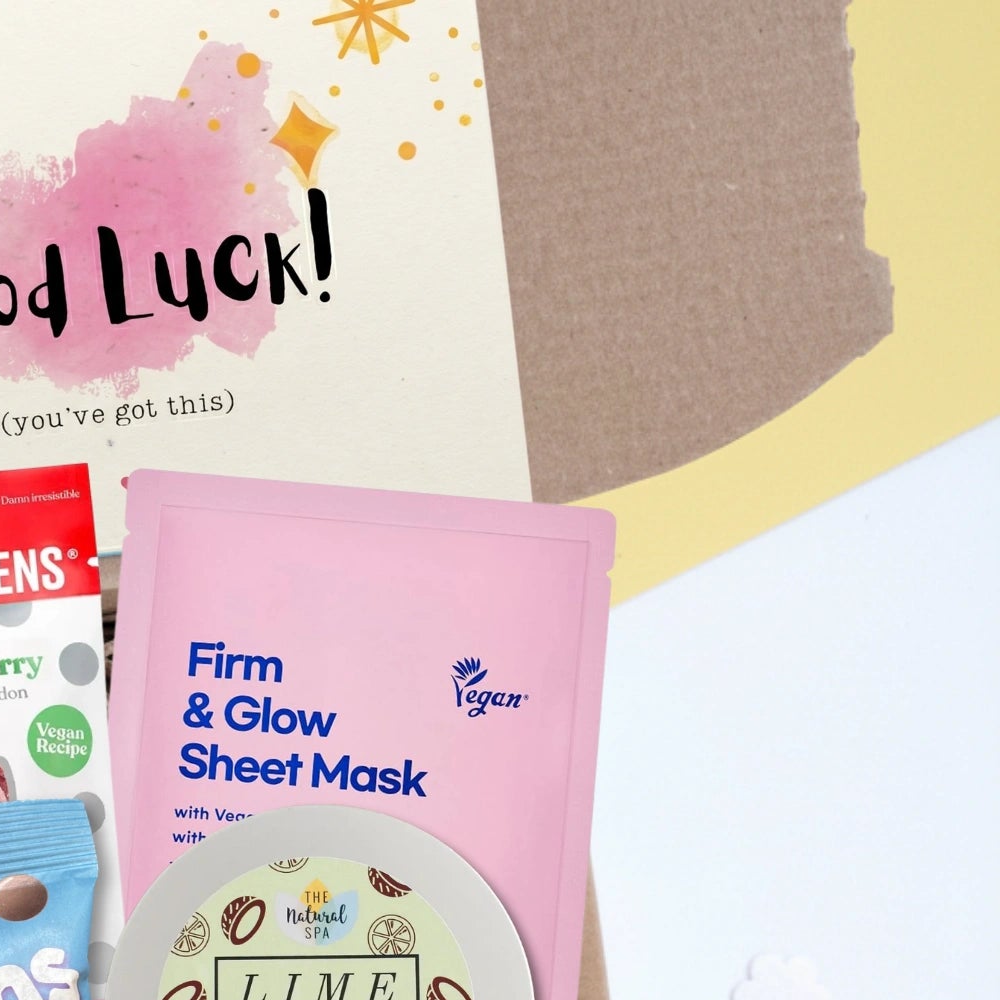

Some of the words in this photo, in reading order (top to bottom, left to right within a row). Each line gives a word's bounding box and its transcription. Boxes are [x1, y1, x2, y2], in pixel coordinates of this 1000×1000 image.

[1, 405, 106, 437] (you've
[115, 400, 158, 427] got
[167, 388, 235, 418] this)
[1, 494, 31, 505] Damn
[31, 489, 80, 502] irresistible
[187, 641, 283, 683] Firm
[182, 691, 214, 730] &
[224, 694, 337, 738] Glow
[36, 721, 85, 740] Vegan
[36, 737, 88, 758] Recipe
[178, 742, 303, 787] Sheet
[311, 752, 428, 797] Mask
[174, 805, 209, 820] with
[304, 890, 329, 904] THE
[305, 926, 330, 940] SPA
